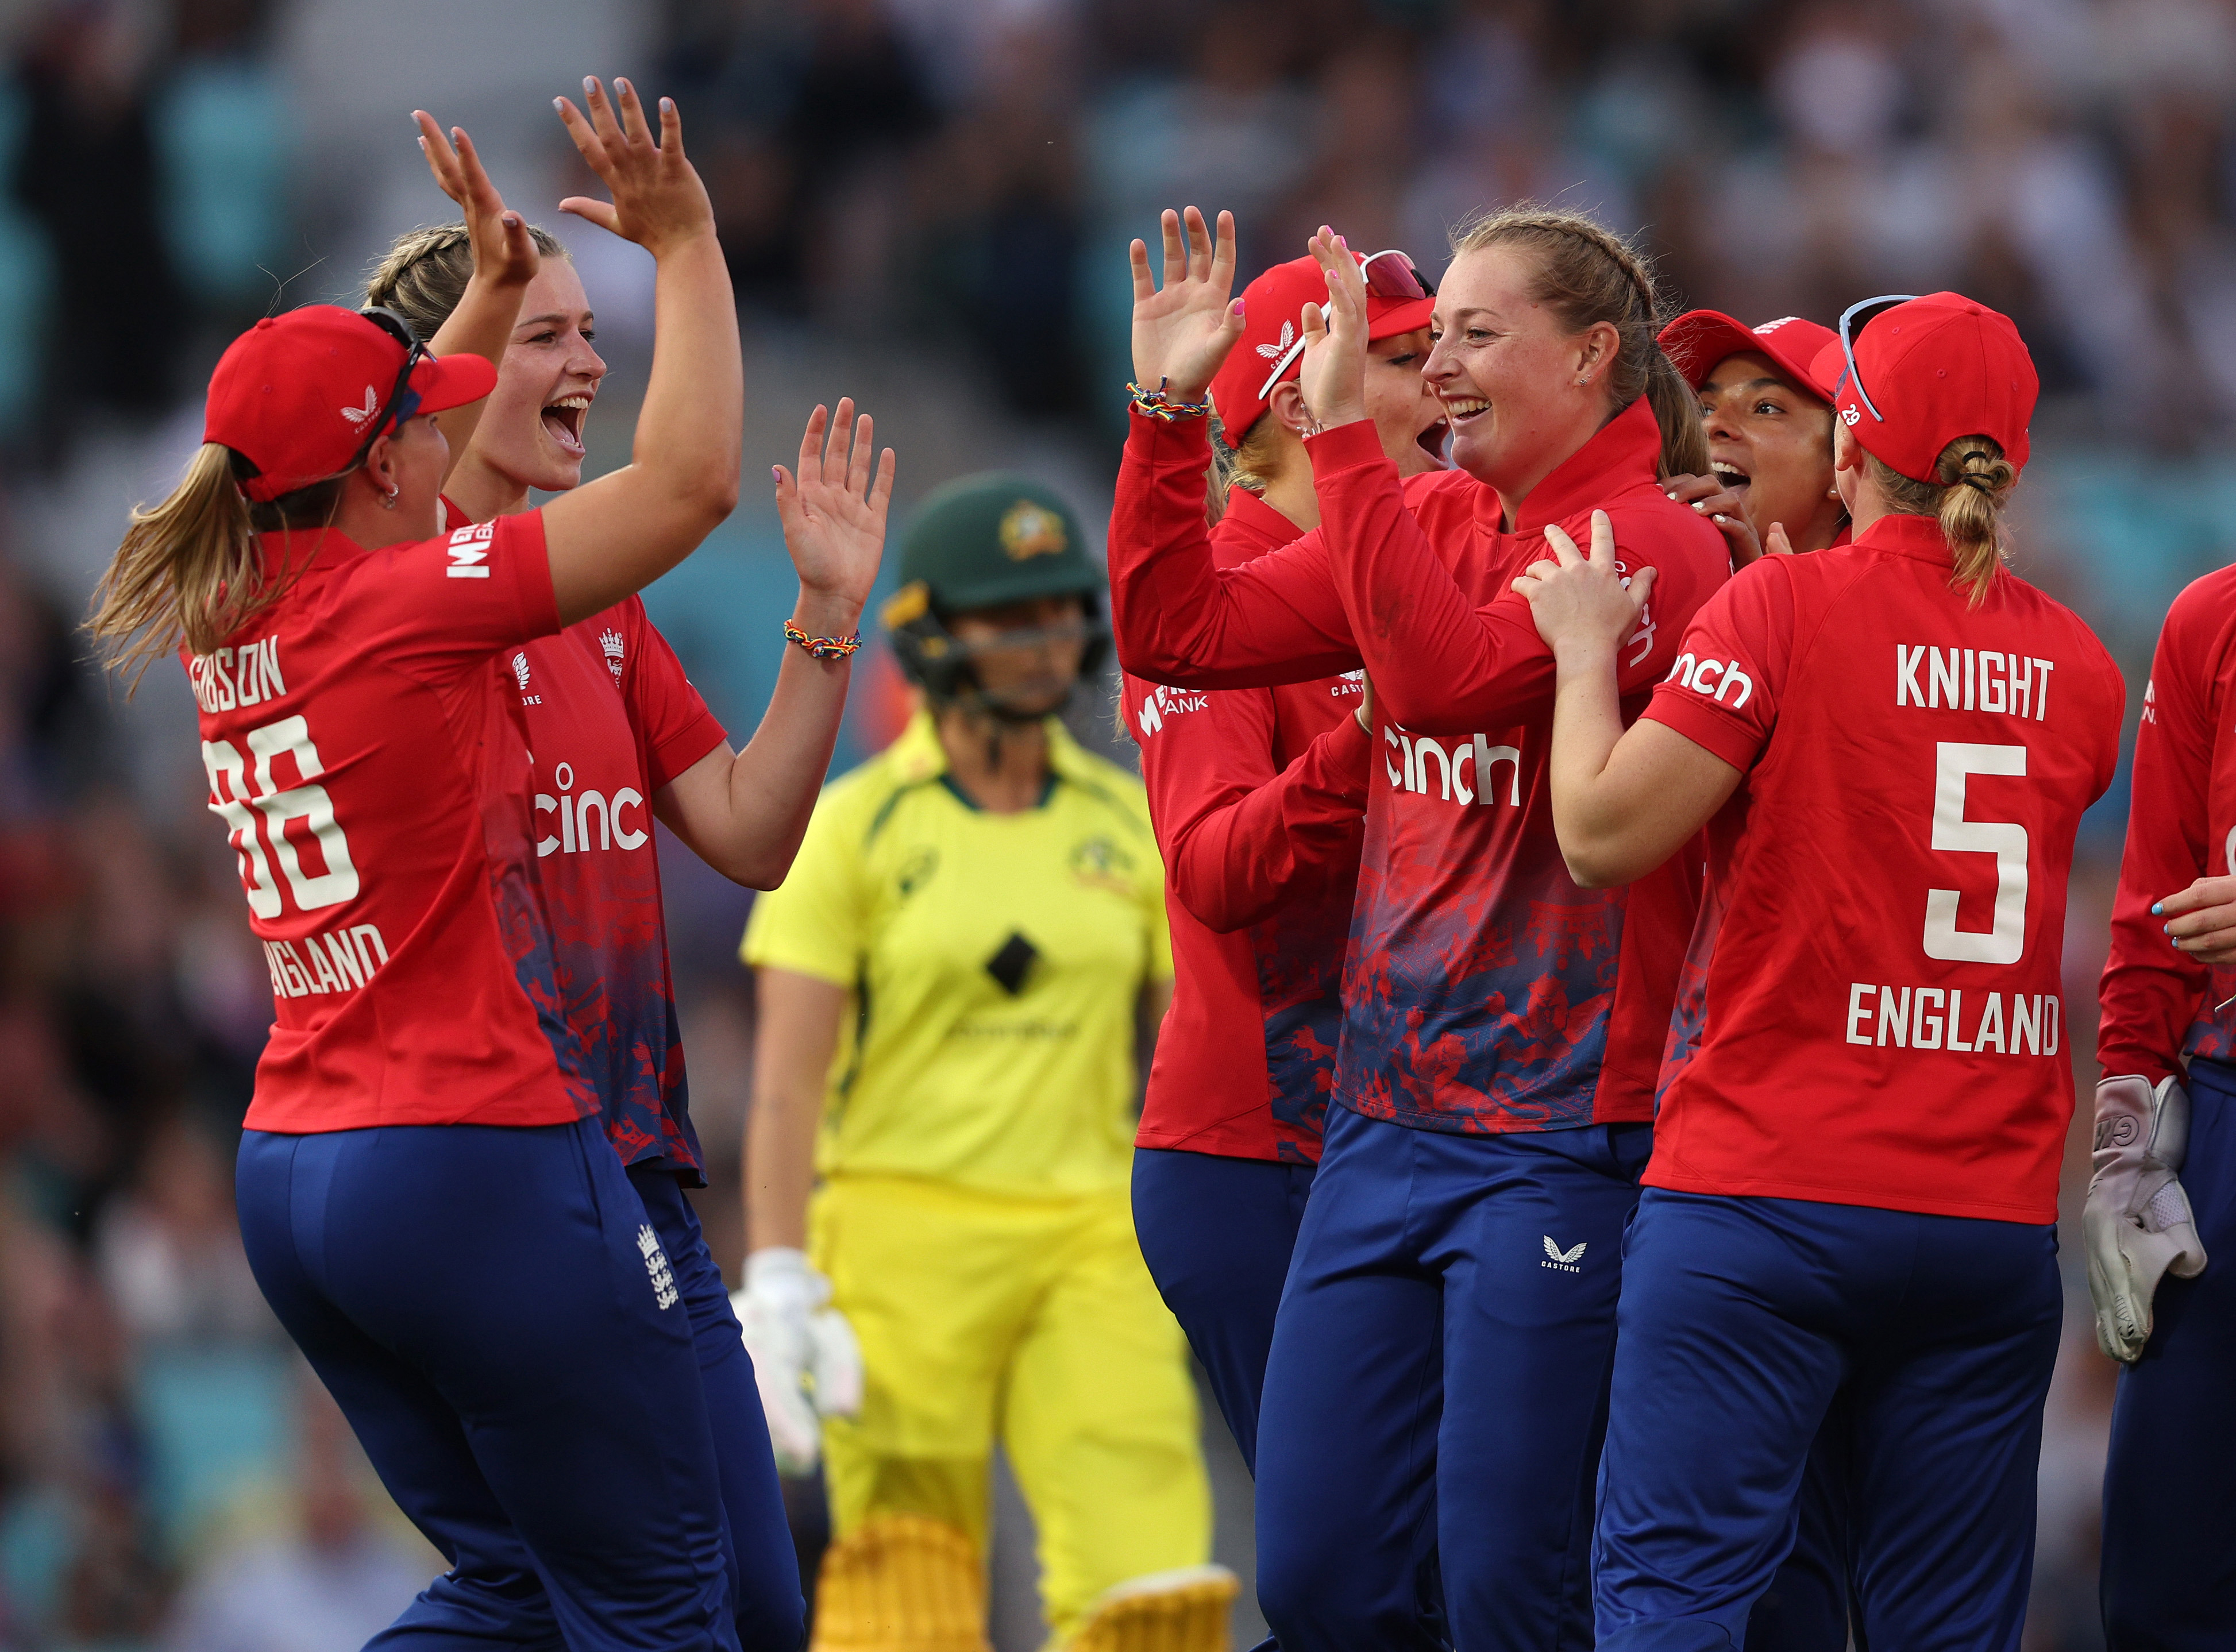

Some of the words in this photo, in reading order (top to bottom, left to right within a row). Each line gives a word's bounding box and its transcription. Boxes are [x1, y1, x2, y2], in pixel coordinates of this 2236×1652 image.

[1842, 404, 1860, 426] 29
[1162, 695, 1209, 715] ANK
[1897, 643, 2054, 721] KNIGHT
[1384, 721, 1521, 806] cinch
[1923, 741, 2028, 964] 5
[263, 924, 390, 998] NGLAND
[1846, 982, 2059, 1056] ENGLAND
[1541, 1261, 1580, 1273] CASTORE
